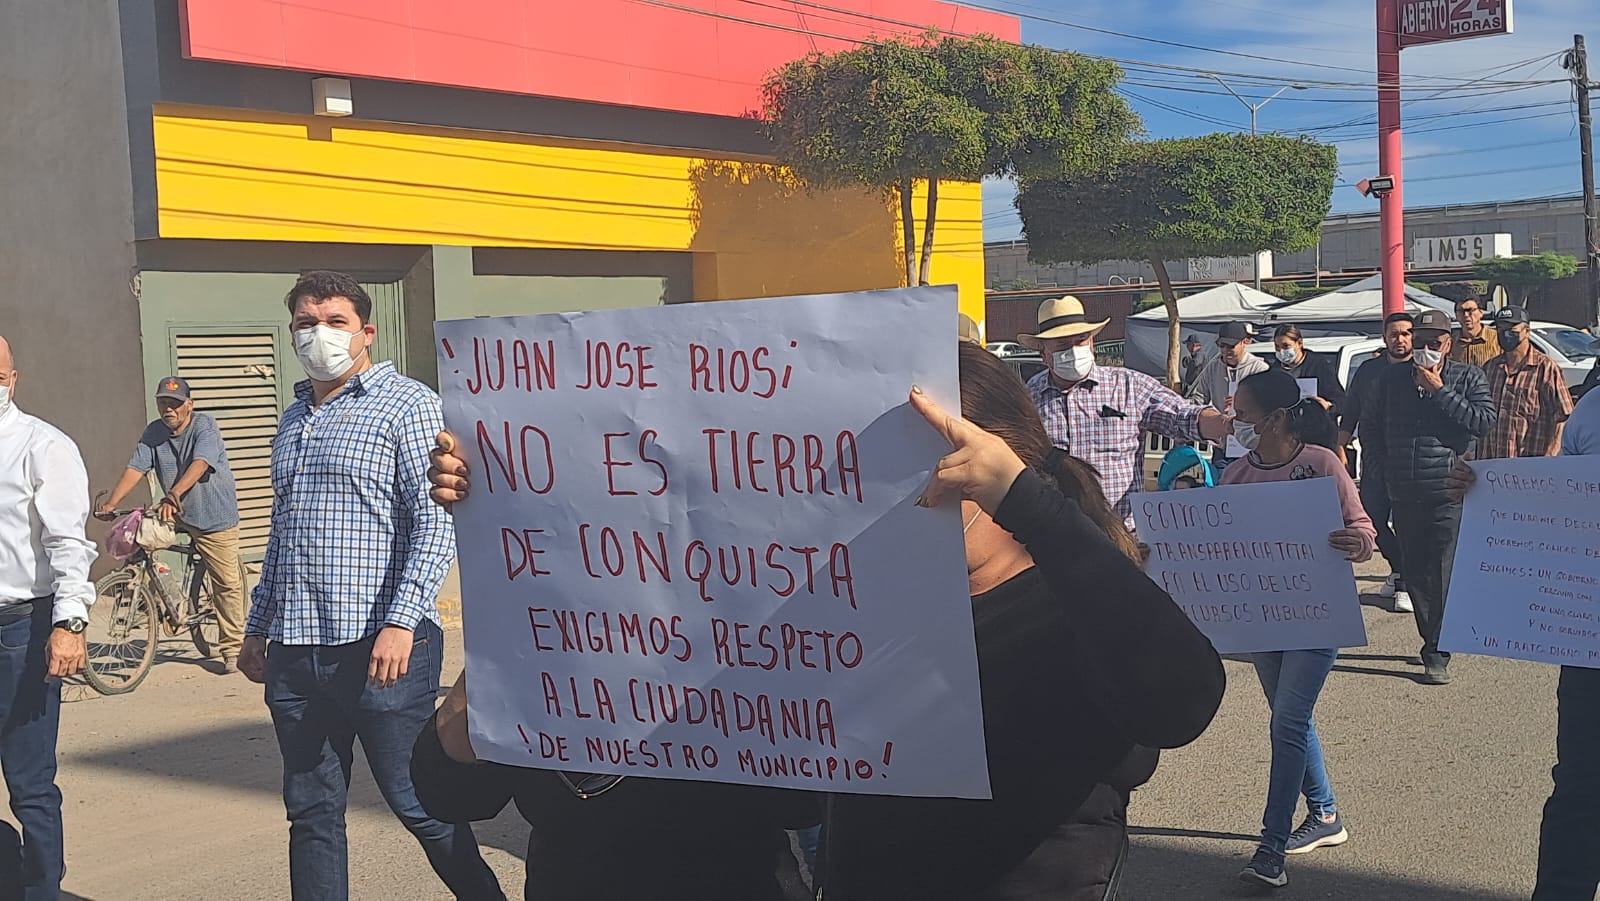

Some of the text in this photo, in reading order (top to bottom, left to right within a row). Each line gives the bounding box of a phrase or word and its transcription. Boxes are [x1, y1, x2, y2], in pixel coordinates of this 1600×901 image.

[1401, 1, 1447, 34] ABIERTO
[1450, 17, 1501, 33] HORAS
[1428, 237, 1483, 262] IMSS
[576, 339, 658, 390] JOSE
[476, 420, 864, 503] NO ES TIERRA
[1486, 536, 1535, 551] QUEREMOS
[501, 523, 858, 610] DE CONQUISTA
[1538, 568, 1552, 581] UN
[1192, 571, 1213, 593] EL
[1217, 572, 1252, 593] USO
[1258, 574, 1281, 593] DE
[1282, 573, 1312, 592] LOS
[1261, 602, 1331, 623] PUBLICOS
[528, 606, 864, 673] EXIGIMOS RESPETO
[1483, 636, 1500, 649] UN
[569, 676, 616, 725] LA
[628, 678, 838, 749] CIUDADANIA
[586, 736, 720, 772] NUESTRO
